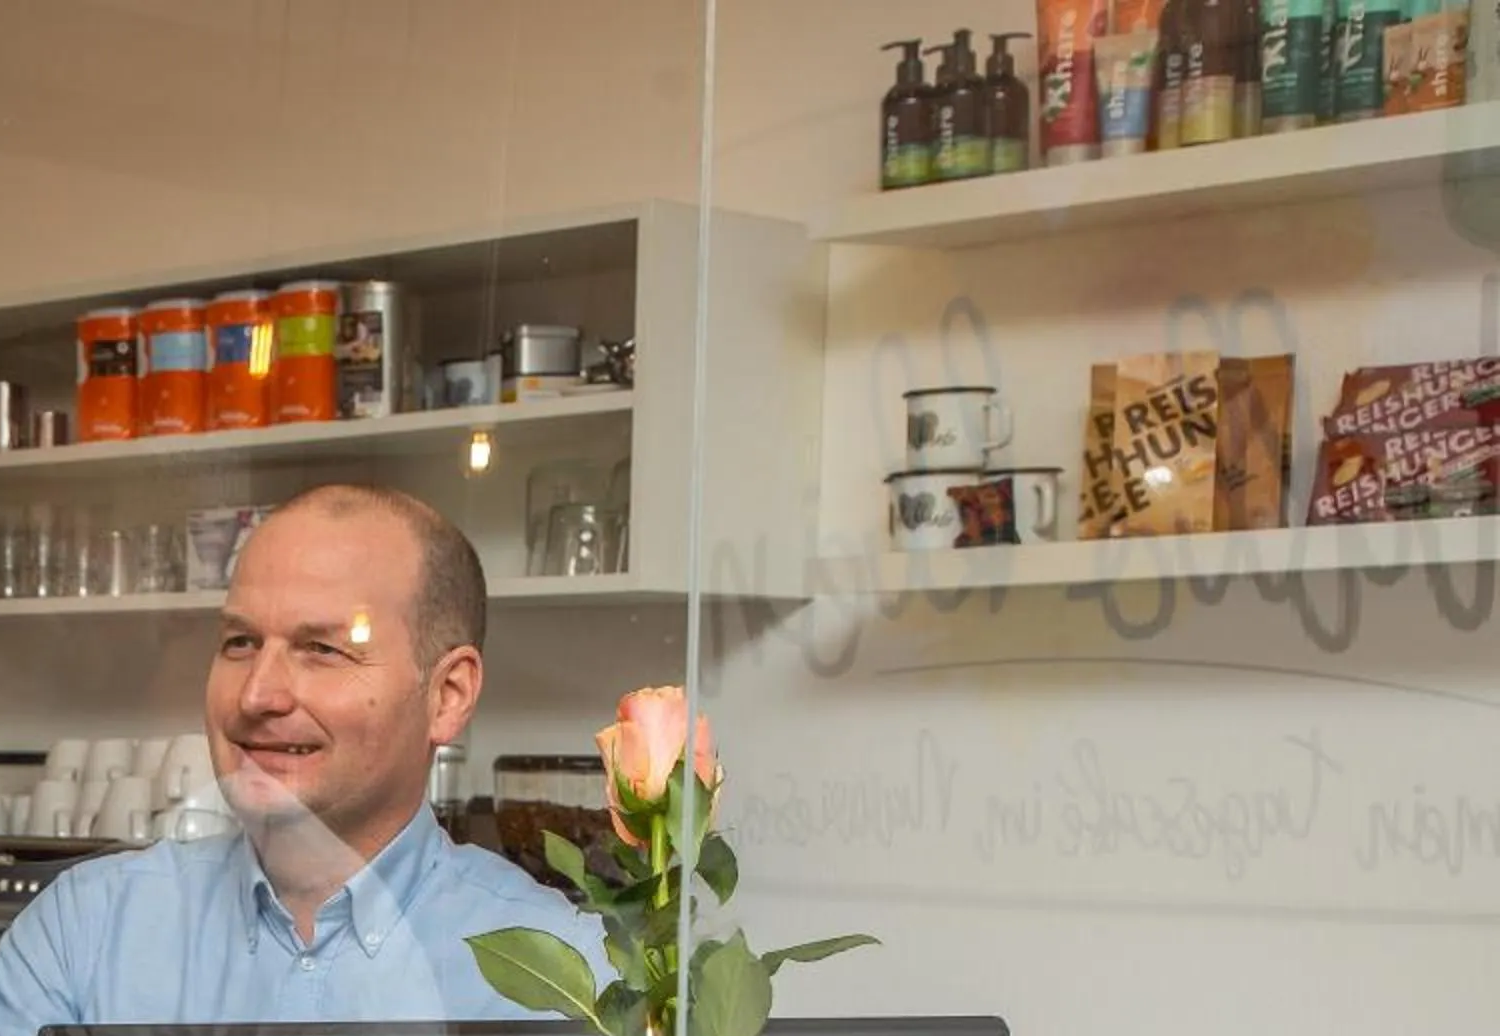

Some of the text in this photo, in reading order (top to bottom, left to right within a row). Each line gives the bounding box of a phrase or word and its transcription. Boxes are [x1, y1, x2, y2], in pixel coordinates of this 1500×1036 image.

[1123, 374, 1217, 434] REIS
[1336, 396, 1401, 434] REIS
[1316, 473, 1378, 517] REIS
